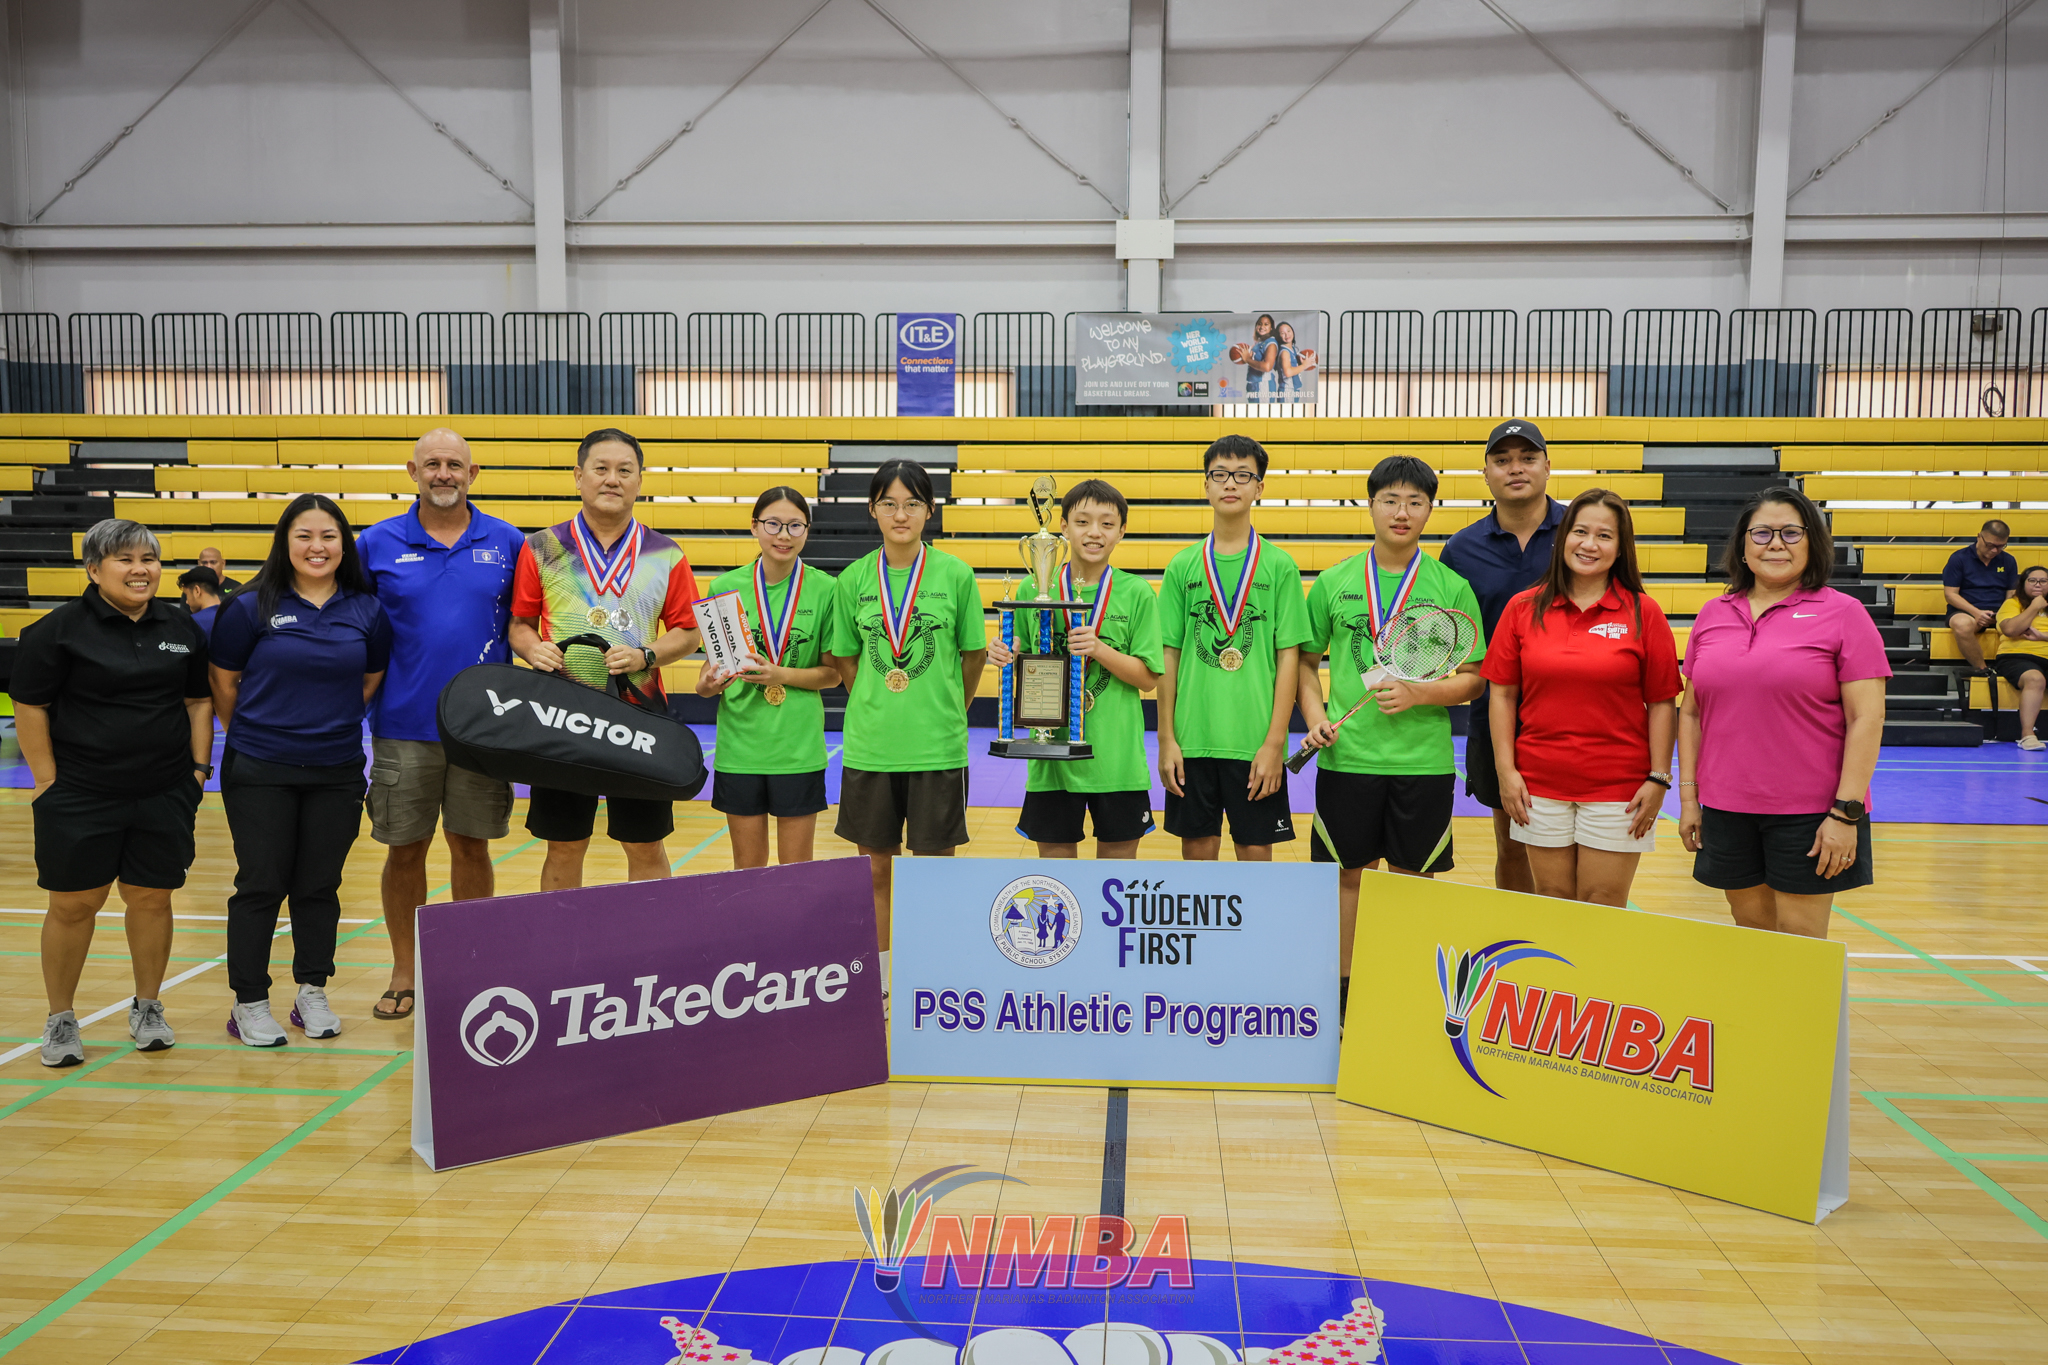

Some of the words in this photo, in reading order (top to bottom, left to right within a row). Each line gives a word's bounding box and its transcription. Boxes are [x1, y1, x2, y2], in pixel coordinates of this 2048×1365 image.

[910, 326, 944, 343] IT&E
[1103, 339, 1120, 352] TO
[1122, 335, 1139, 353] MY
[1186, 330, 1201, 339] HER
[900, 356, 954, 365] Connections
[1186, 351, 1210, 363] RULES
[1189, 345, 1204, 355] HER
[904, 365, 921, 373] that
[922, 365, 950, 373] matter
[1342, 593, 1364, 601] NMBA
[722, 616, 737, 653] VICTOR
[740, 613, 750, 633] 2000
[707, 621, 723, 659] VICTOR
[528, 700, 657, 755] VICTOR
[993, 888, 1013, 932] COMMONWEALTH
[1012, 884, 1020, 892] OF
[1020, 879, 1031, 888] THE
[1032, 879, 1061, 892] NORTHERN
[1060, 889, 1076, 912] MARIANA
[1102, 878, 1242, 927] STUDENTS
[1000, 941, 1020, 960] PUBLIC
[1020, 956, 1047, 965] SCHOOL
[1048, 943, 1070, 962] SYSTEM
[1119, 927, 1197, 968] FIRST
[913, 988, 987, 1032] PSS
[994, 990, 1133, 1035] Athletic
[1143, 992, 1319, 1048] Programs
[1479, 979, 1714, 1092] NMBA
[1476, 1044, 1527, 1064] NORTHERN
[1527, 1055, 1579, 1076] MARIANAS
[1580, 1067, 1640, 1090] BADMINTON
[1641, 1081, 1713, 1106] ASSOCIATION
